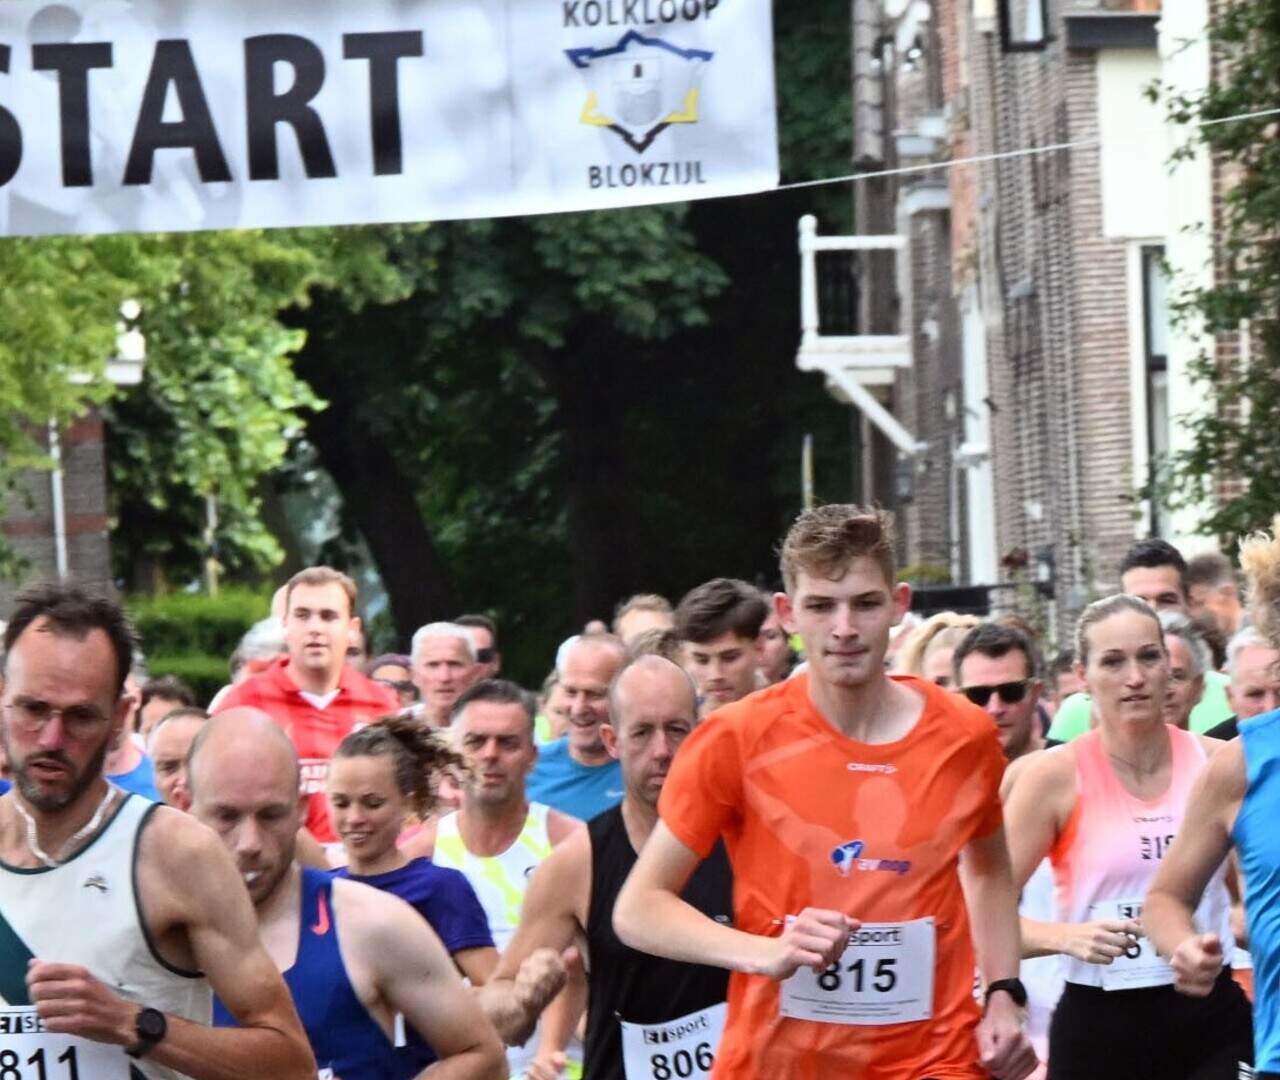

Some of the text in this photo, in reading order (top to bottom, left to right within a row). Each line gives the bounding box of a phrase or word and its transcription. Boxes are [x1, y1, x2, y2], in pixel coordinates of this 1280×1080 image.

[563, 0, 719, 27] KOLKLOOP
[588, 161, 706, 188] BLOKZIJL
[817, 958, 898, 993] 815
[651, 1042, 714, 1080] 806
